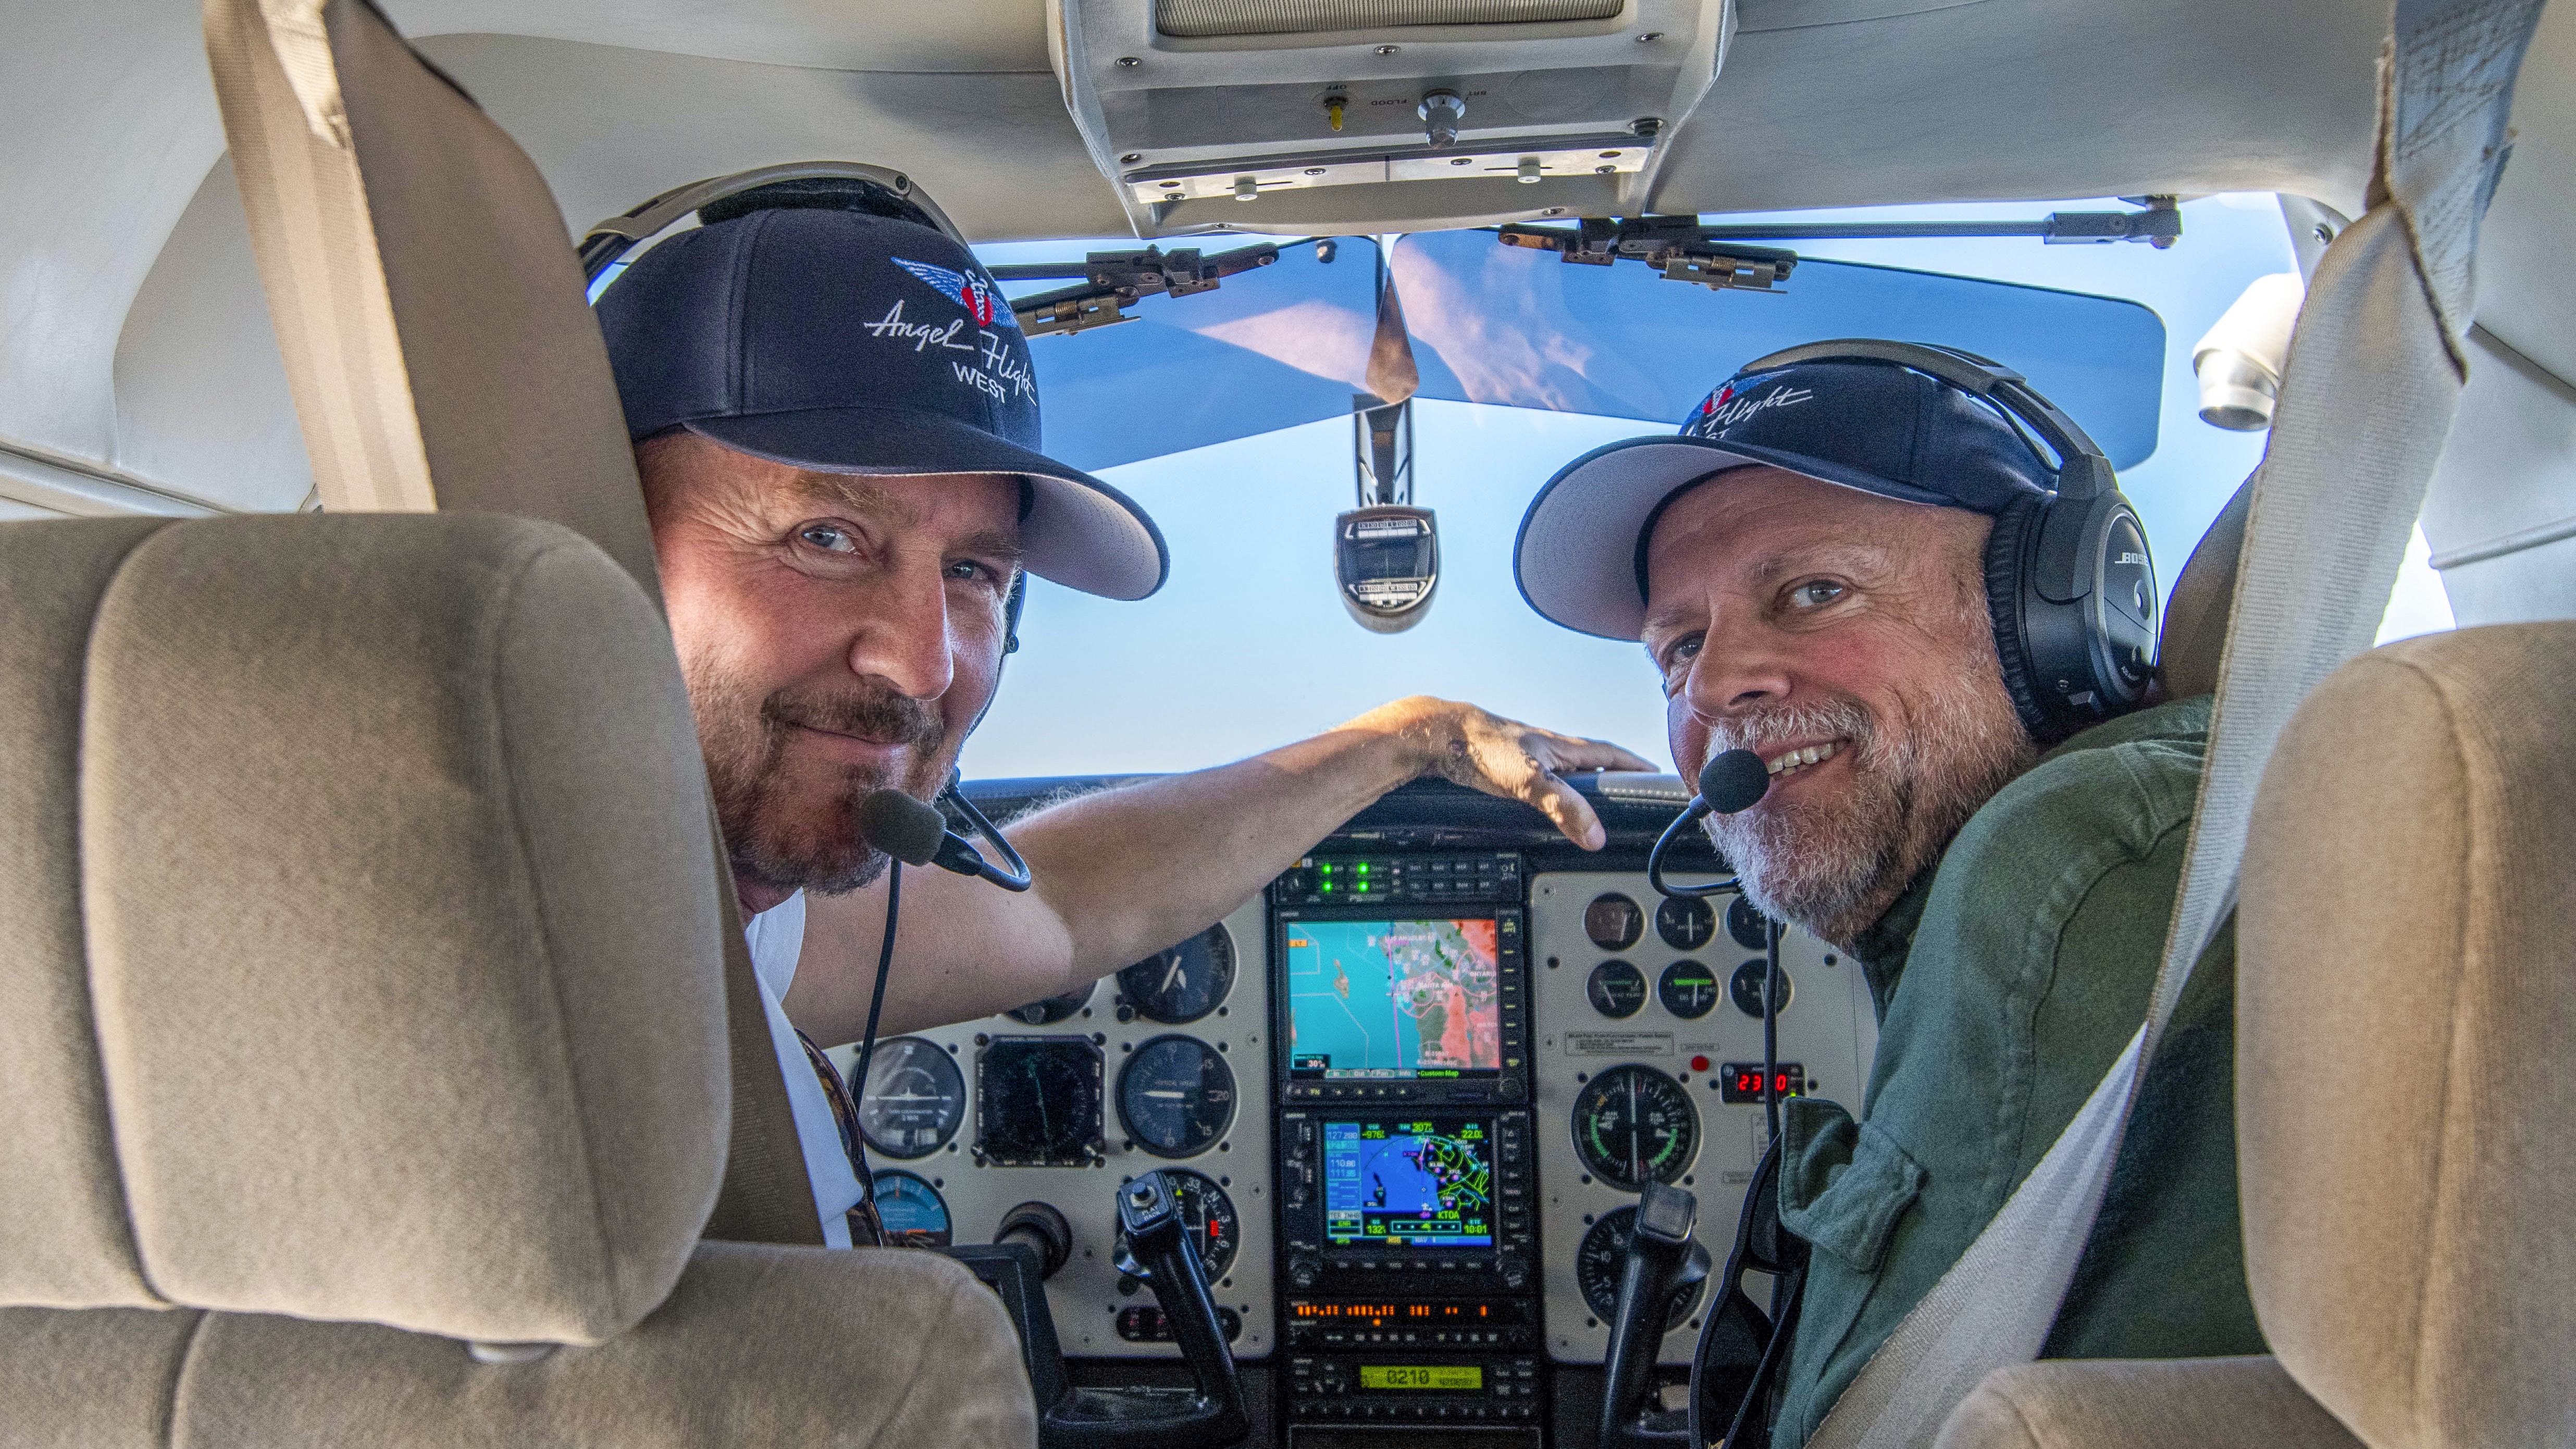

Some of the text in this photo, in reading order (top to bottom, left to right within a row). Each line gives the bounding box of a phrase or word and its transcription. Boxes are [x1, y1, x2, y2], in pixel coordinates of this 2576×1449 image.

[863, 299, 1037, 406] Angel Flight
[951, 361, 1006, 404] WEST
[1703, 385, 1813, 434] Flight
[2114, 552, 2149, 567] BOSE
[1204, 1059, 1215, 1069] 15
[1738, 1074, 1788, 1092] 230
[1217, 1091, 1229, 1100] 20
[1202, 1126, 1213, 1136] 15
[1187, 1177, 1200, 1189] 33
[1208, 1190, 1220, 1202] N
[1142, 1206, 1158, 1217] PLAY
[1144, 1211, 1161, 1222] BACK
[1437, 1210, 1460, 1219] KTOA
[1220, 1215, 1231, 1223] 3
[1465, 1224, 1487, 1234] 10:01
